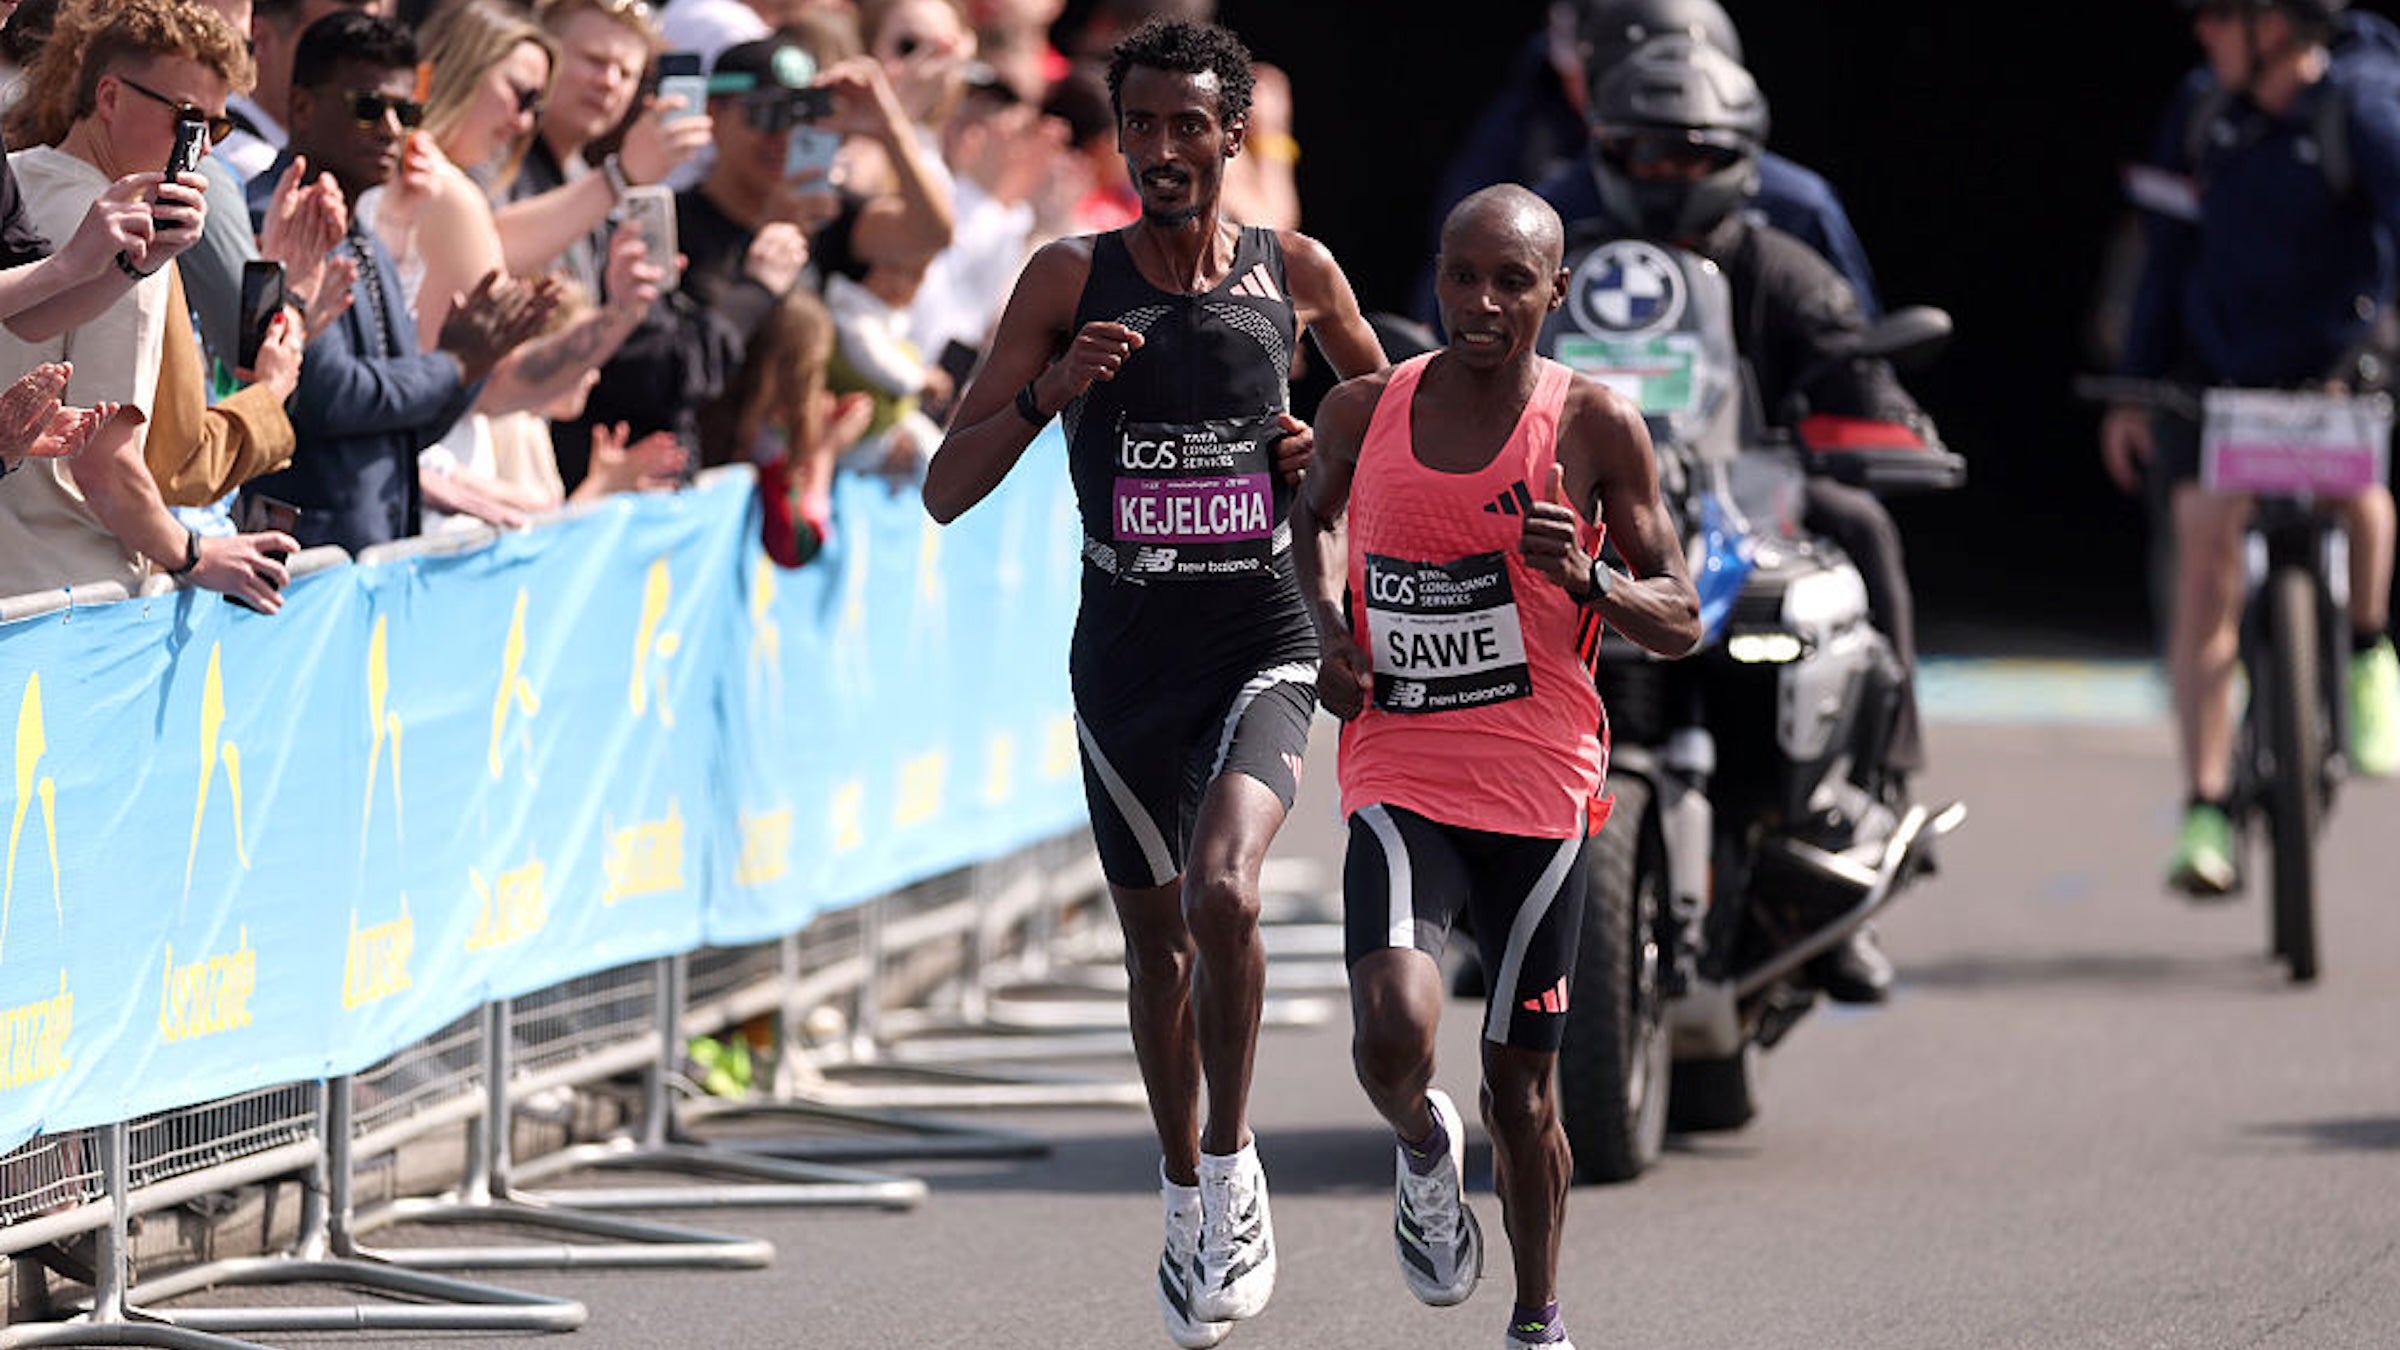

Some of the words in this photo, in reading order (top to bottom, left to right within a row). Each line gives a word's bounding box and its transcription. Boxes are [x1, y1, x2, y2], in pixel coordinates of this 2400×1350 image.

[1122, 432, 1177, 469] tcs
[1183, 433, 1218, 443] TATA
[1182, 455, 1235, 469] SERVICES
[1119, 492, 1267, 535] KEJELCHA
[1178, 563, 1206, 573] new
[1208, 558, 1260, 573] balance
[1370, 564, 1415, 605] tcs
[1388, 627, 1500, 669] SAWE
[1429, 694, 1457, 706] new
[1459, 683, 1517, 701] balance
